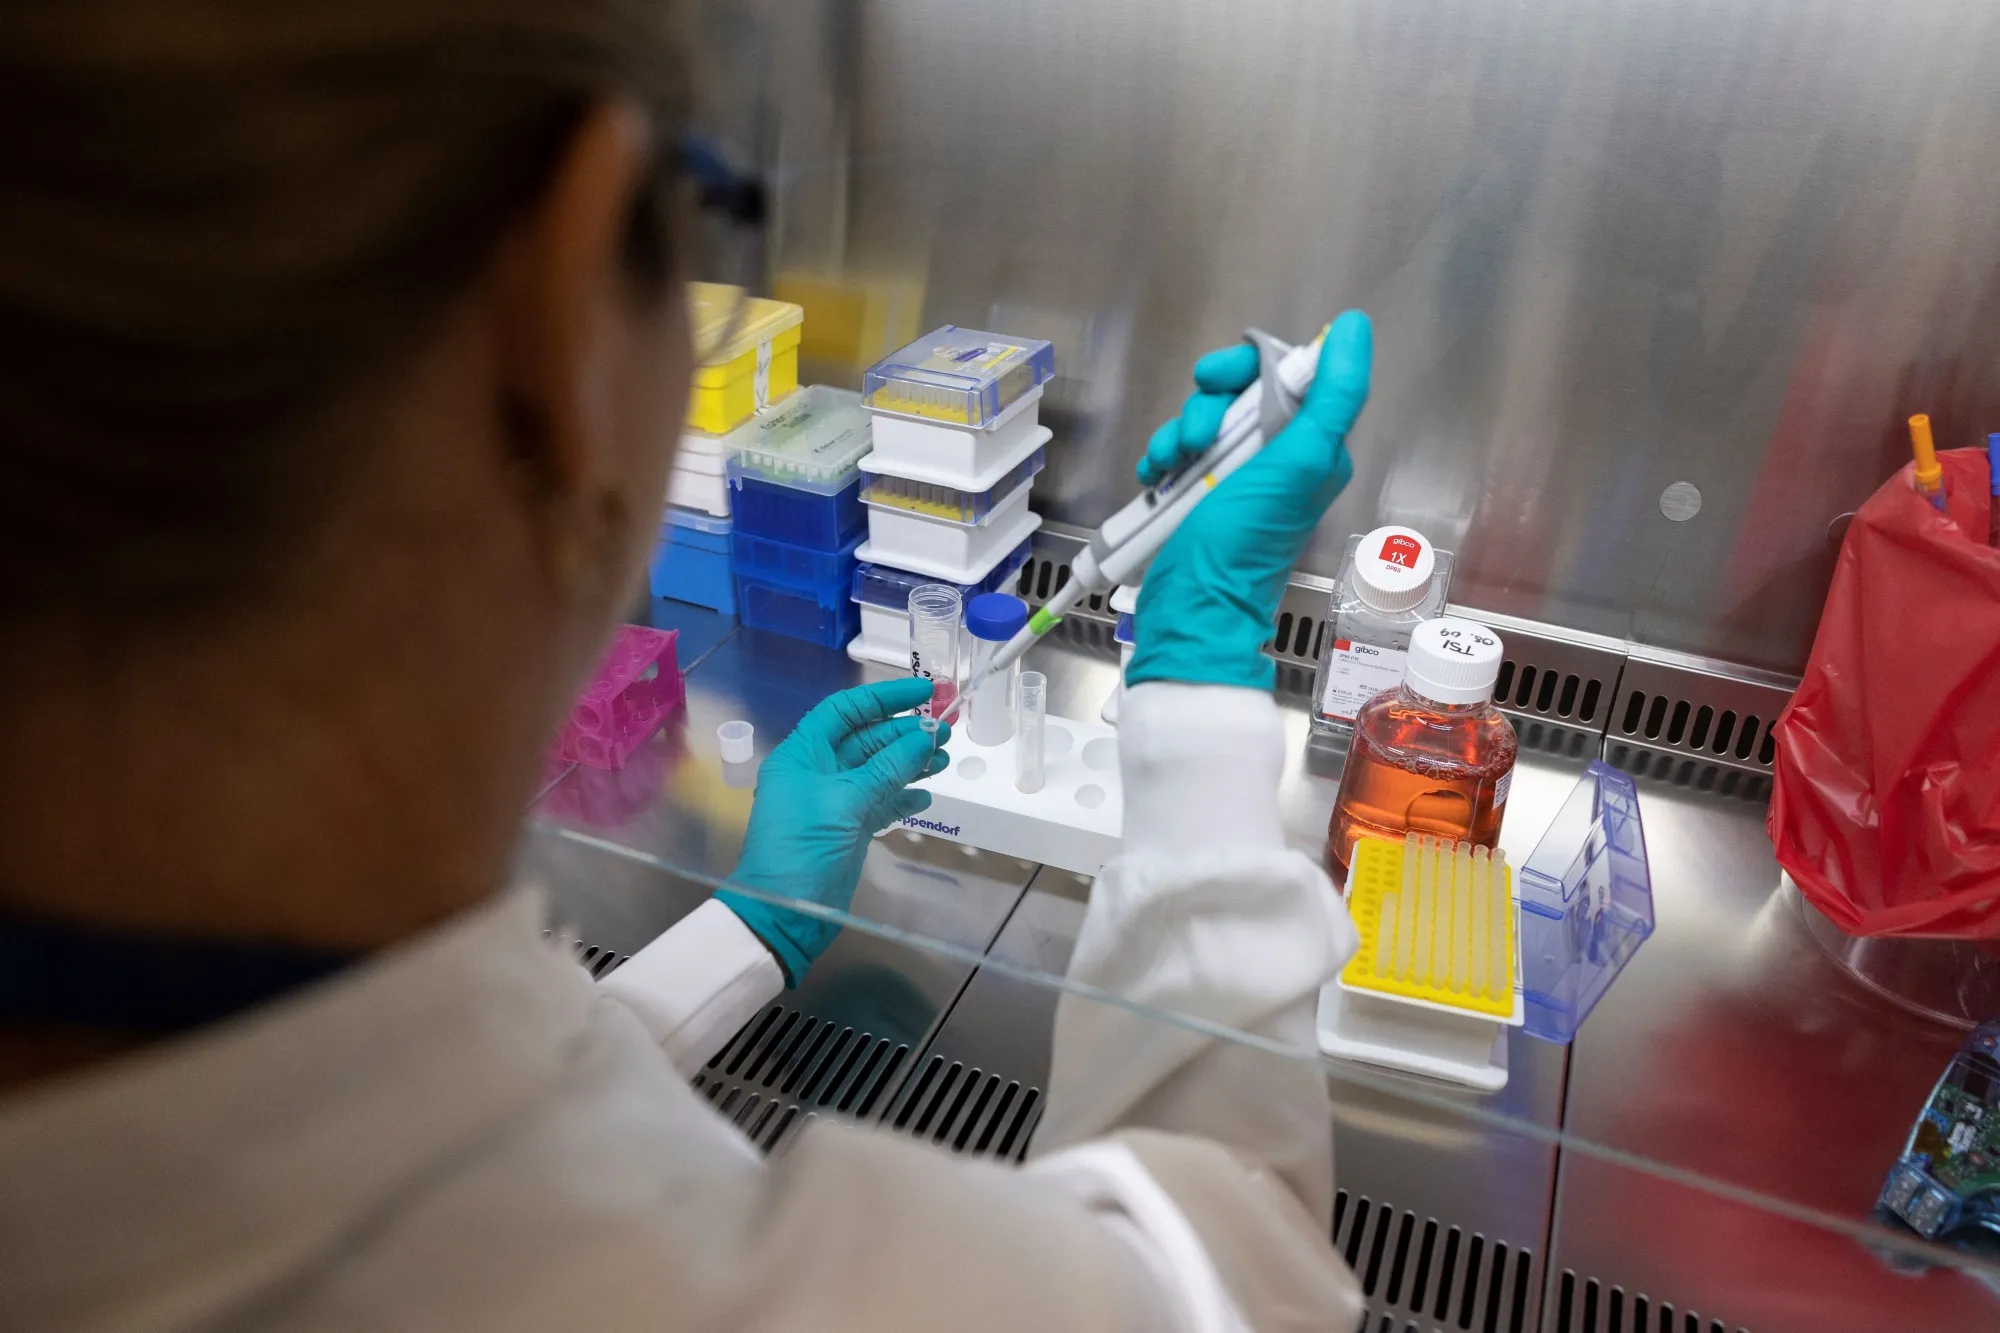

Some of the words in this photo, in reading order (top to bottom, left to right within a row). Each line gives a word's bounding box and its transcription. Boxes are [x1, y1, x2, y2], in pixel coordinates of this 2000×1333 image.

[1393, 538, 1415, 548] gibco
[1391, 551, 1408, 565] 1X
[1385, 564, 1402, 573] DPBS
[1354, 646, 1380, 656] gibco
[1442, 639, 1475, 656] TSI
[902, 816, 961, 836] ppendorf
